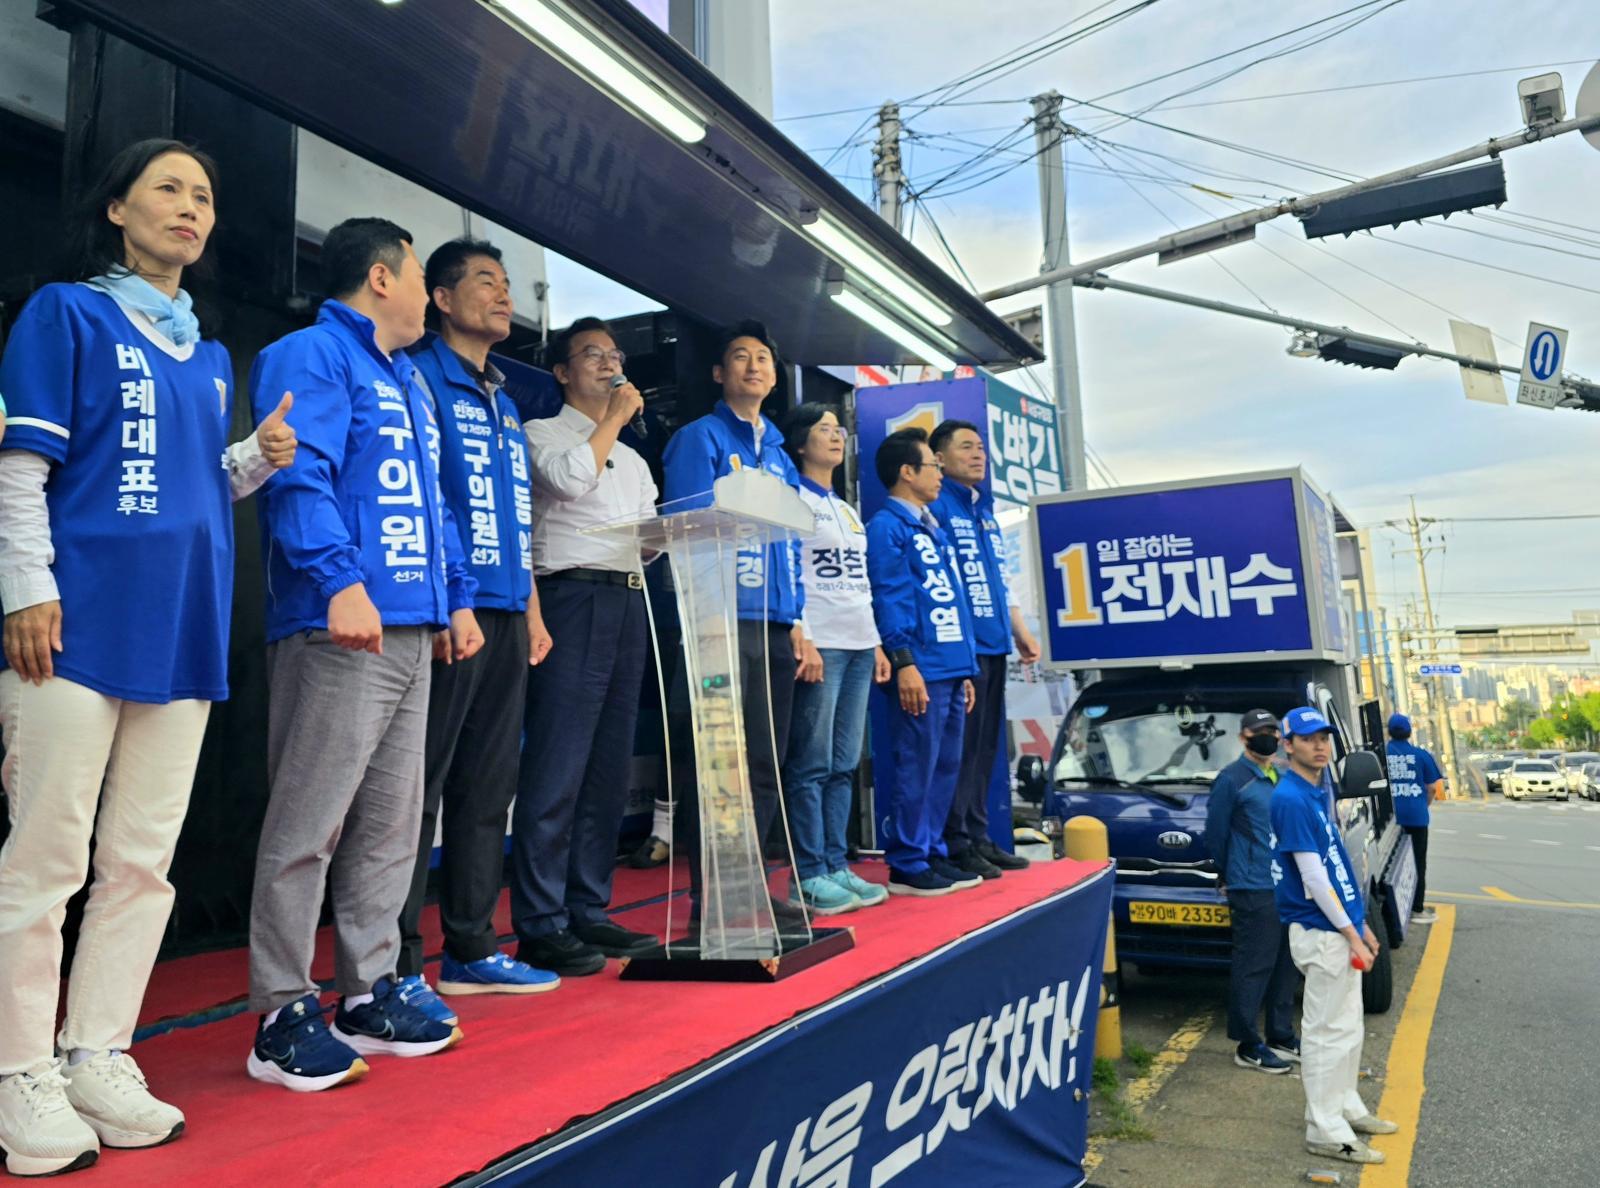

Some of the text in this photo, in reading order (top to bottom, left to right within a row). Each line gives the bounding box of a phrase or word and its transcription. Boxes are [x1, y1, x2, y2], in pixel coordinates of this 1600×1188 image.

[115, 343, 158, 492] 비례대표
[116, 494, 159, 516] 후보
[377, 401, 428, 566] 구의원
[462, 438, 500, 547] 구의원
[392, 570, 424, 583] 선거
[470, 548, 501, 566] 선거
[957, 538, 993, 606] 구의원
[1096, 533, 1194, 562] 일 잘하는
[913, 533, 964, 643] 정성열
[1053, 542, 1104, 628] 1
[1100, 552, 1298, 624] 전재수
[1181, 906, 1225, 923] 2335
[870, 965, 1091, 1188] 으랏차차!
